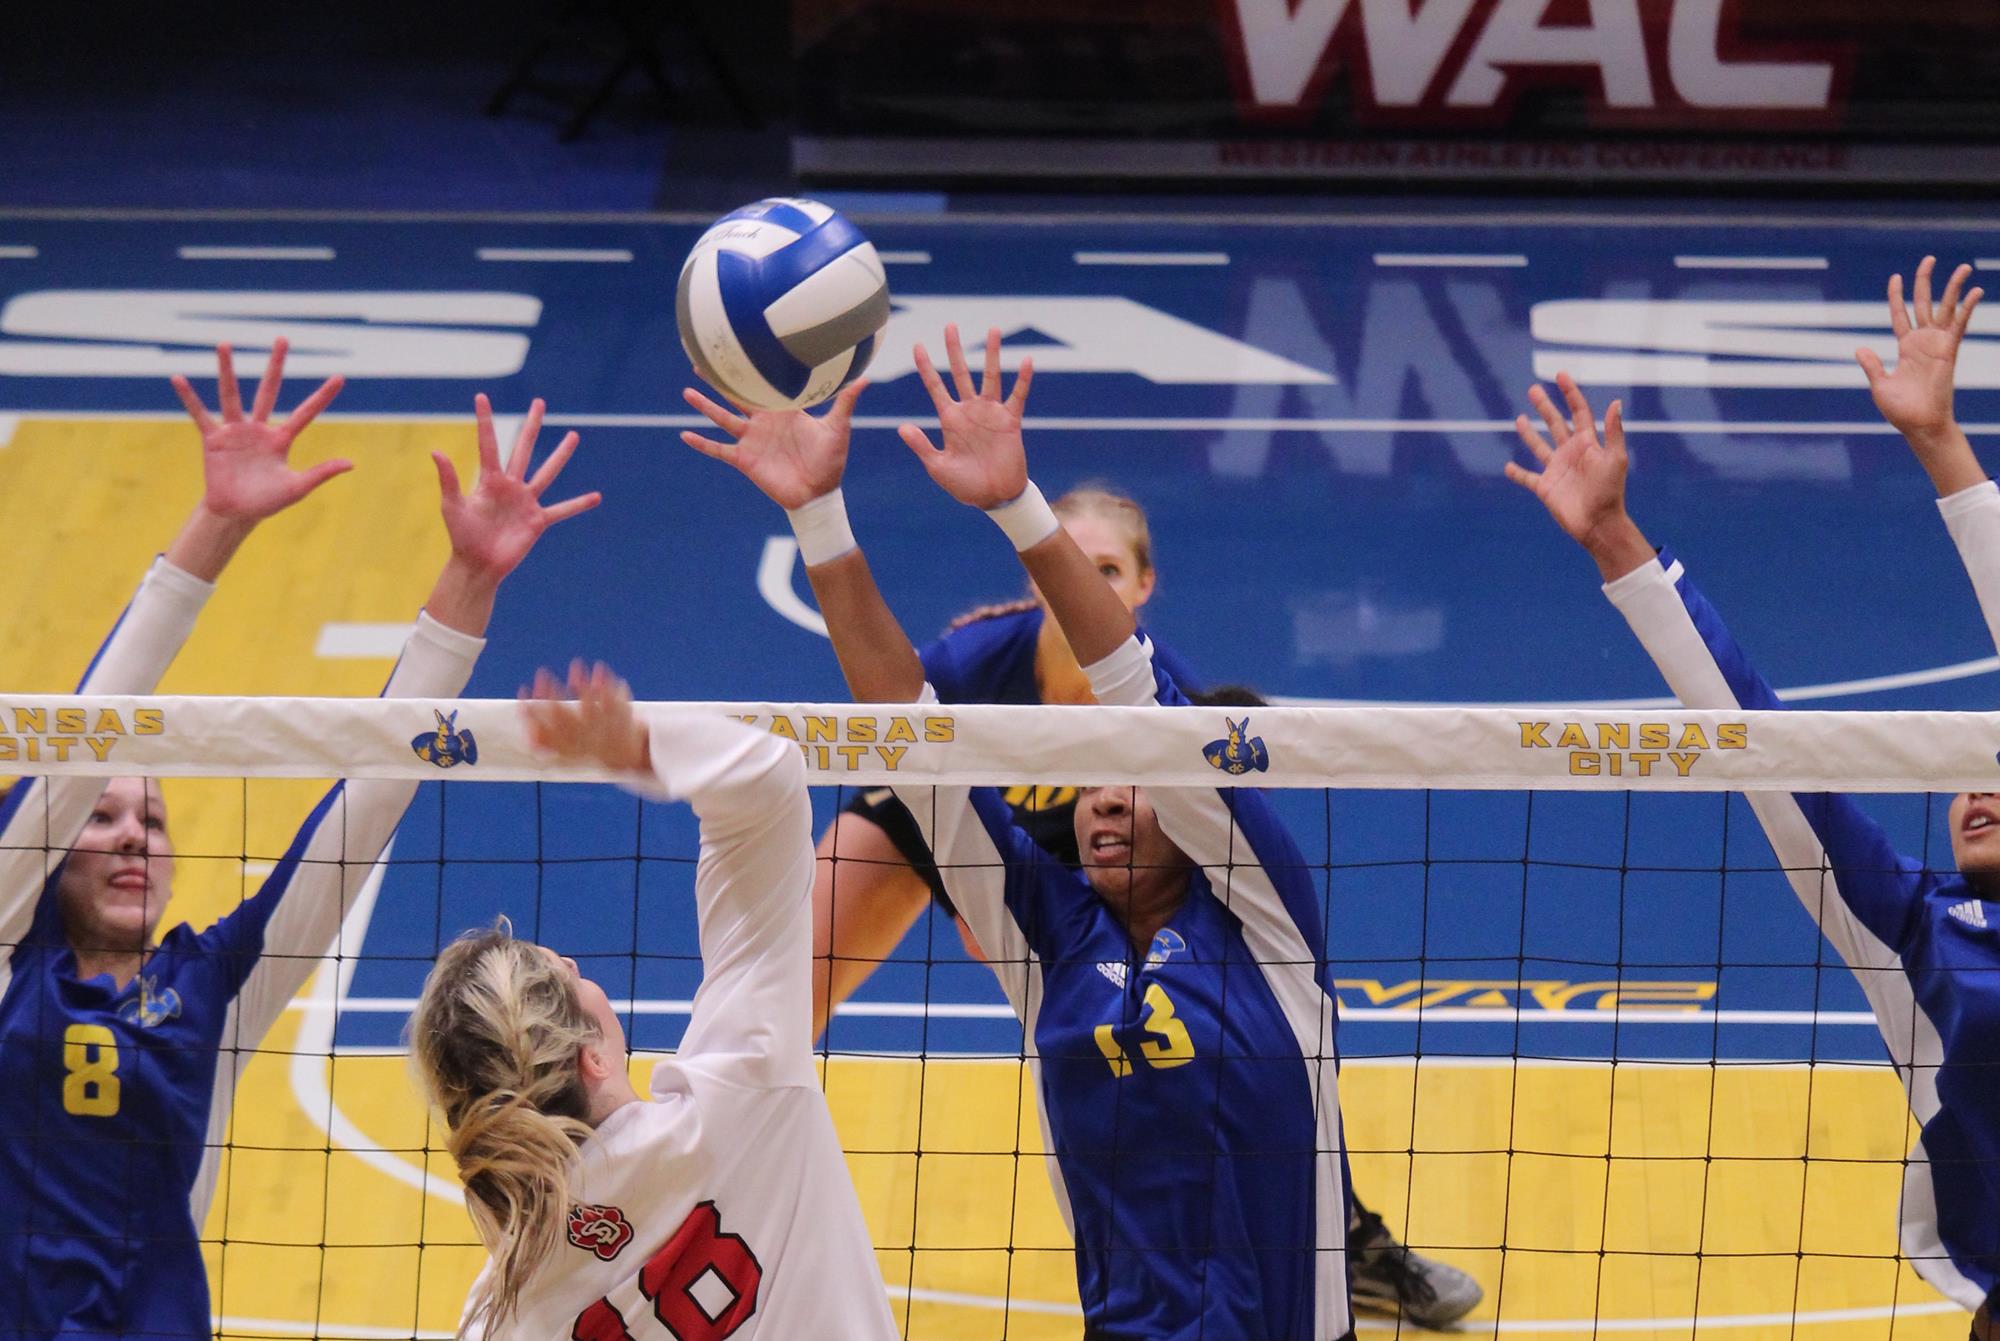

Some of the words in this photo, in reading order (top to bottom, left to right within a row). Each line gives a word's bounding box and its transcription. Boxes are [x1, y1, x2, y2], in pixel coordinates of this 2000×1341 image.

[1233, 0, 1835, 108] WAC
[0, 707, 164, 735] NSAS
[1518, 722, 1748, 749] KANSAS
[800, 744, 909, 771] ITY
[1569, 751, 1701, 776] CITY
[63, 1023, 121, 1117] 8
